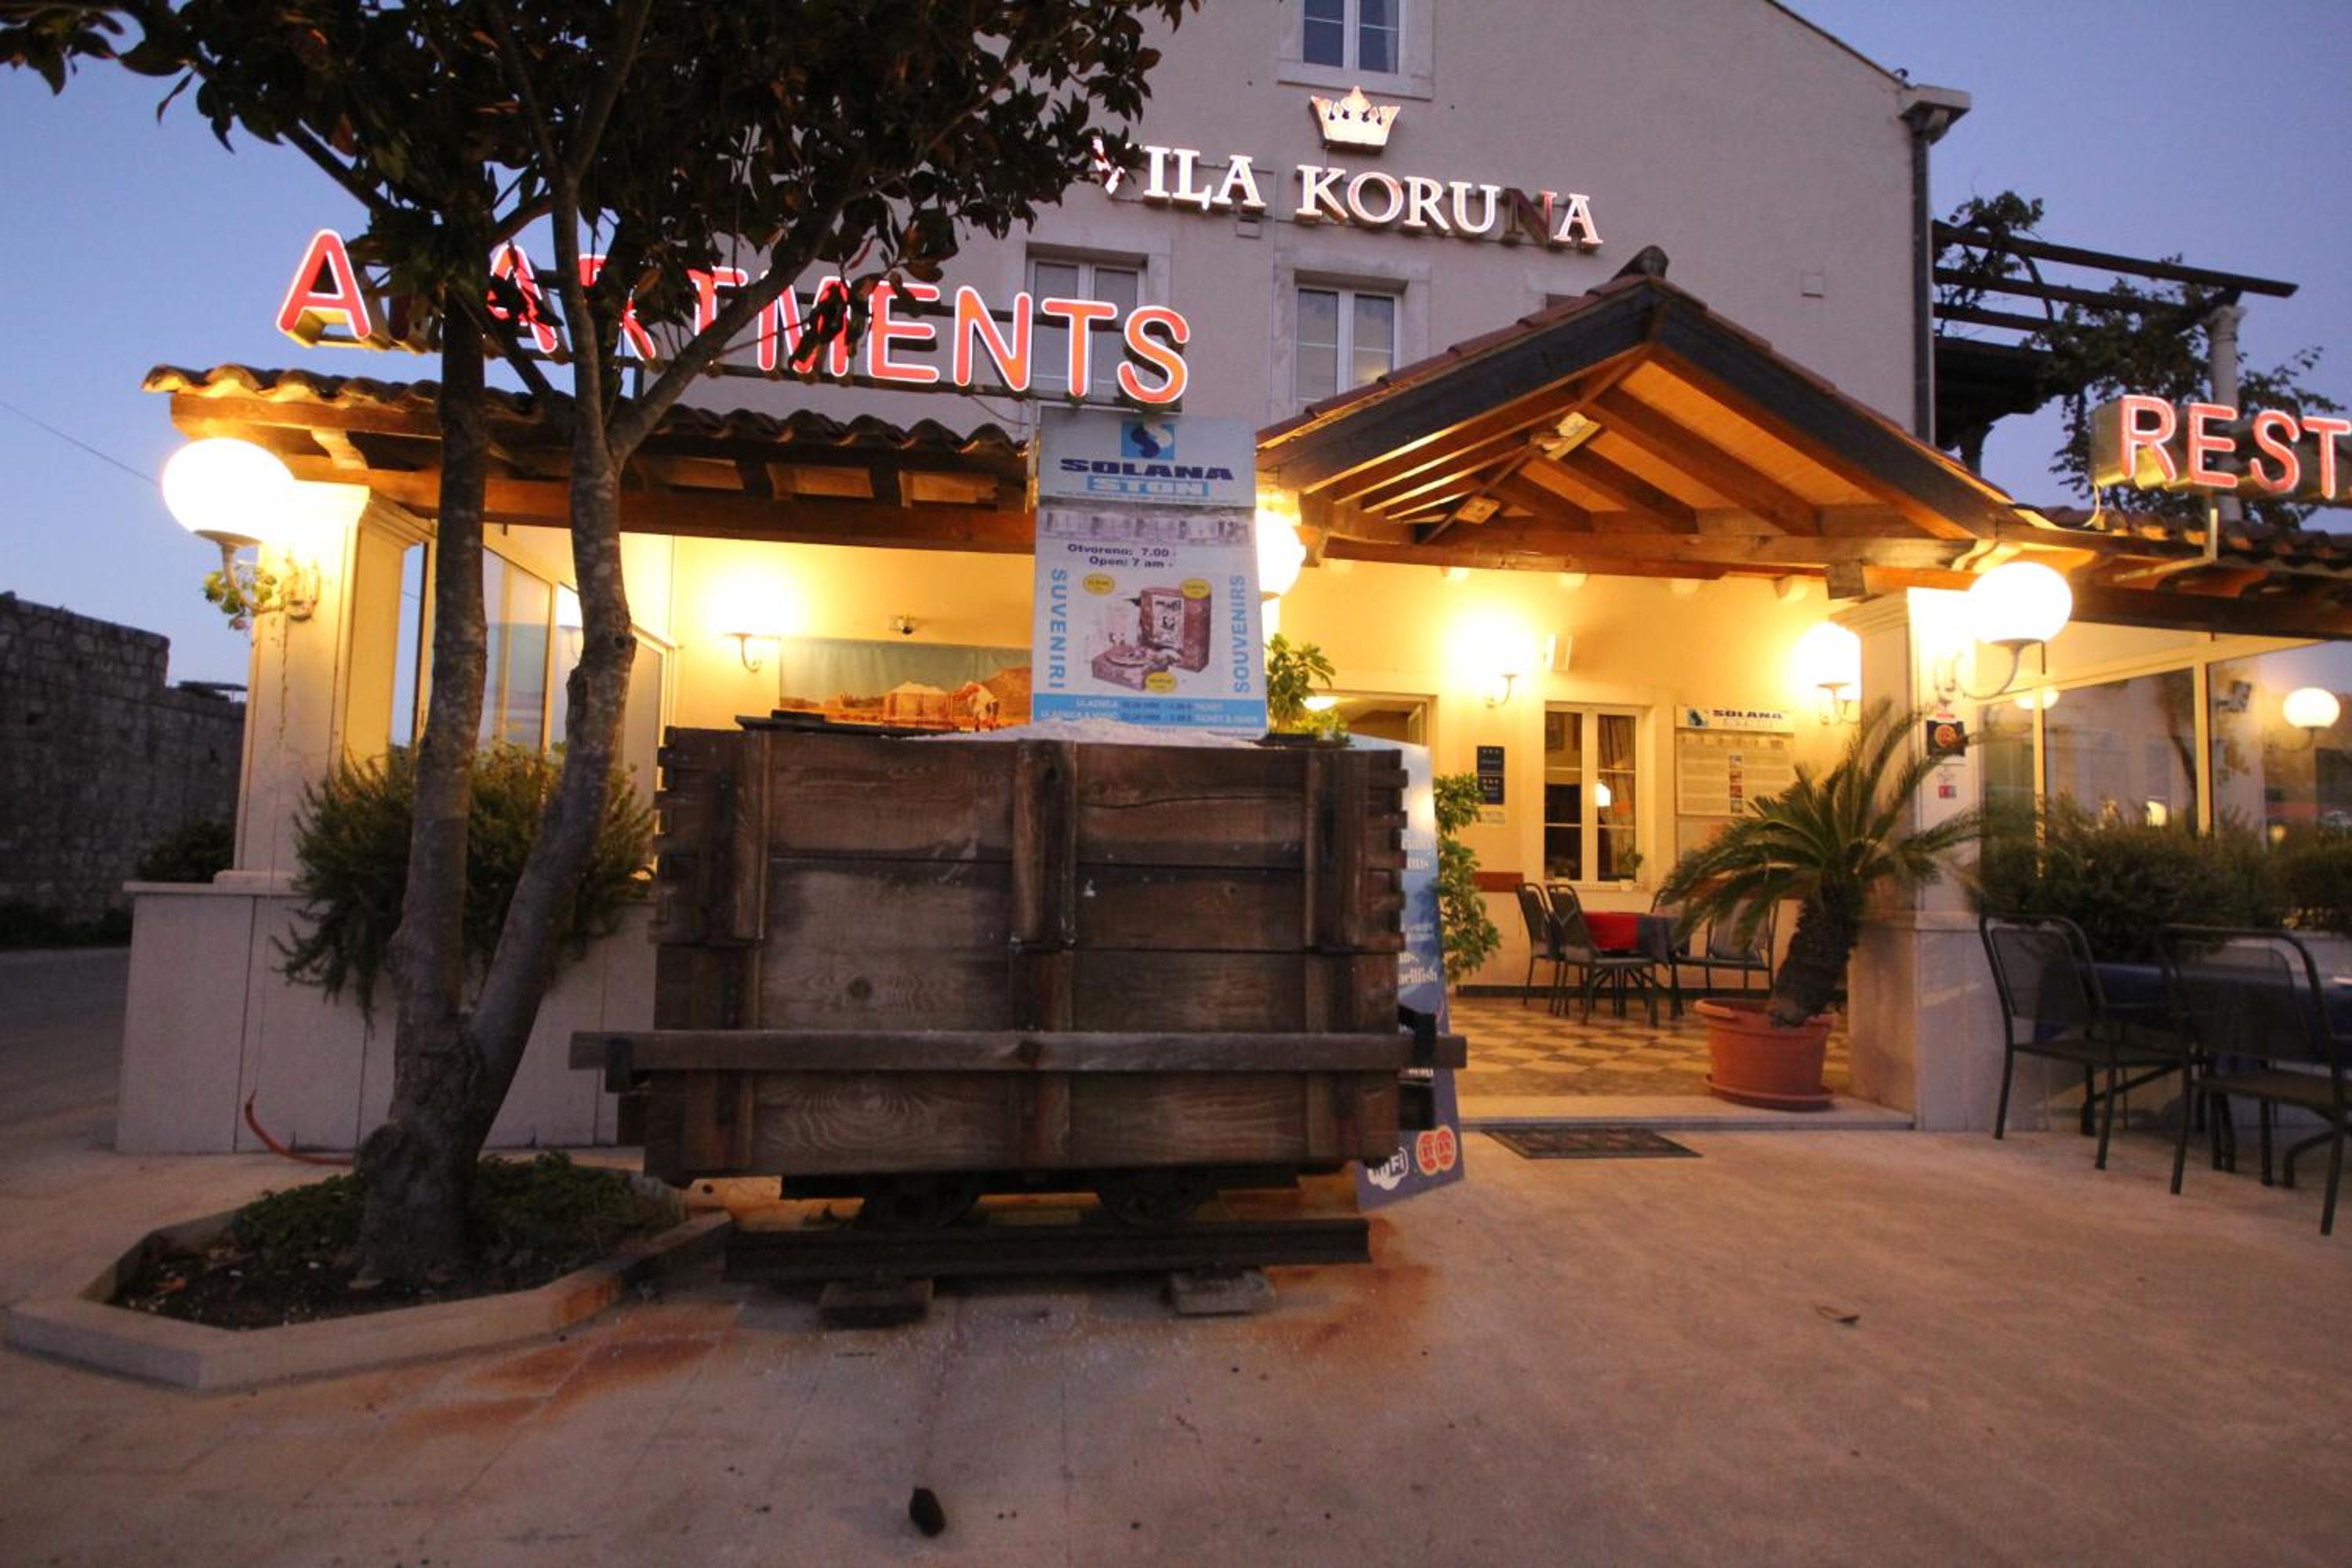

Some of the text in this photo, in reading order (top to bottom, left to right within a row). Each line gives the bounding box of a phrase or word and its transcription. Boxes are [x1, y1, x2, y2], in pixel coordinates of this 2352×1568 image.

[1295, 164, 1604, 249] KORUNA
[1060, 459, 1233, 481] SOLANA
[1067, 543, 1133, 557] Otvoreno:
[1142, 546, 1170, 557] 7.00
[1088, 556, 1128, 568] Open:
[1132, 557, 1140, 567] 7
[1144, 559, 1165, 568] am
[1048, 568, 1069, 689] SUVENIRI
[1229, 575, 1251, 694] SOUVENIRS
